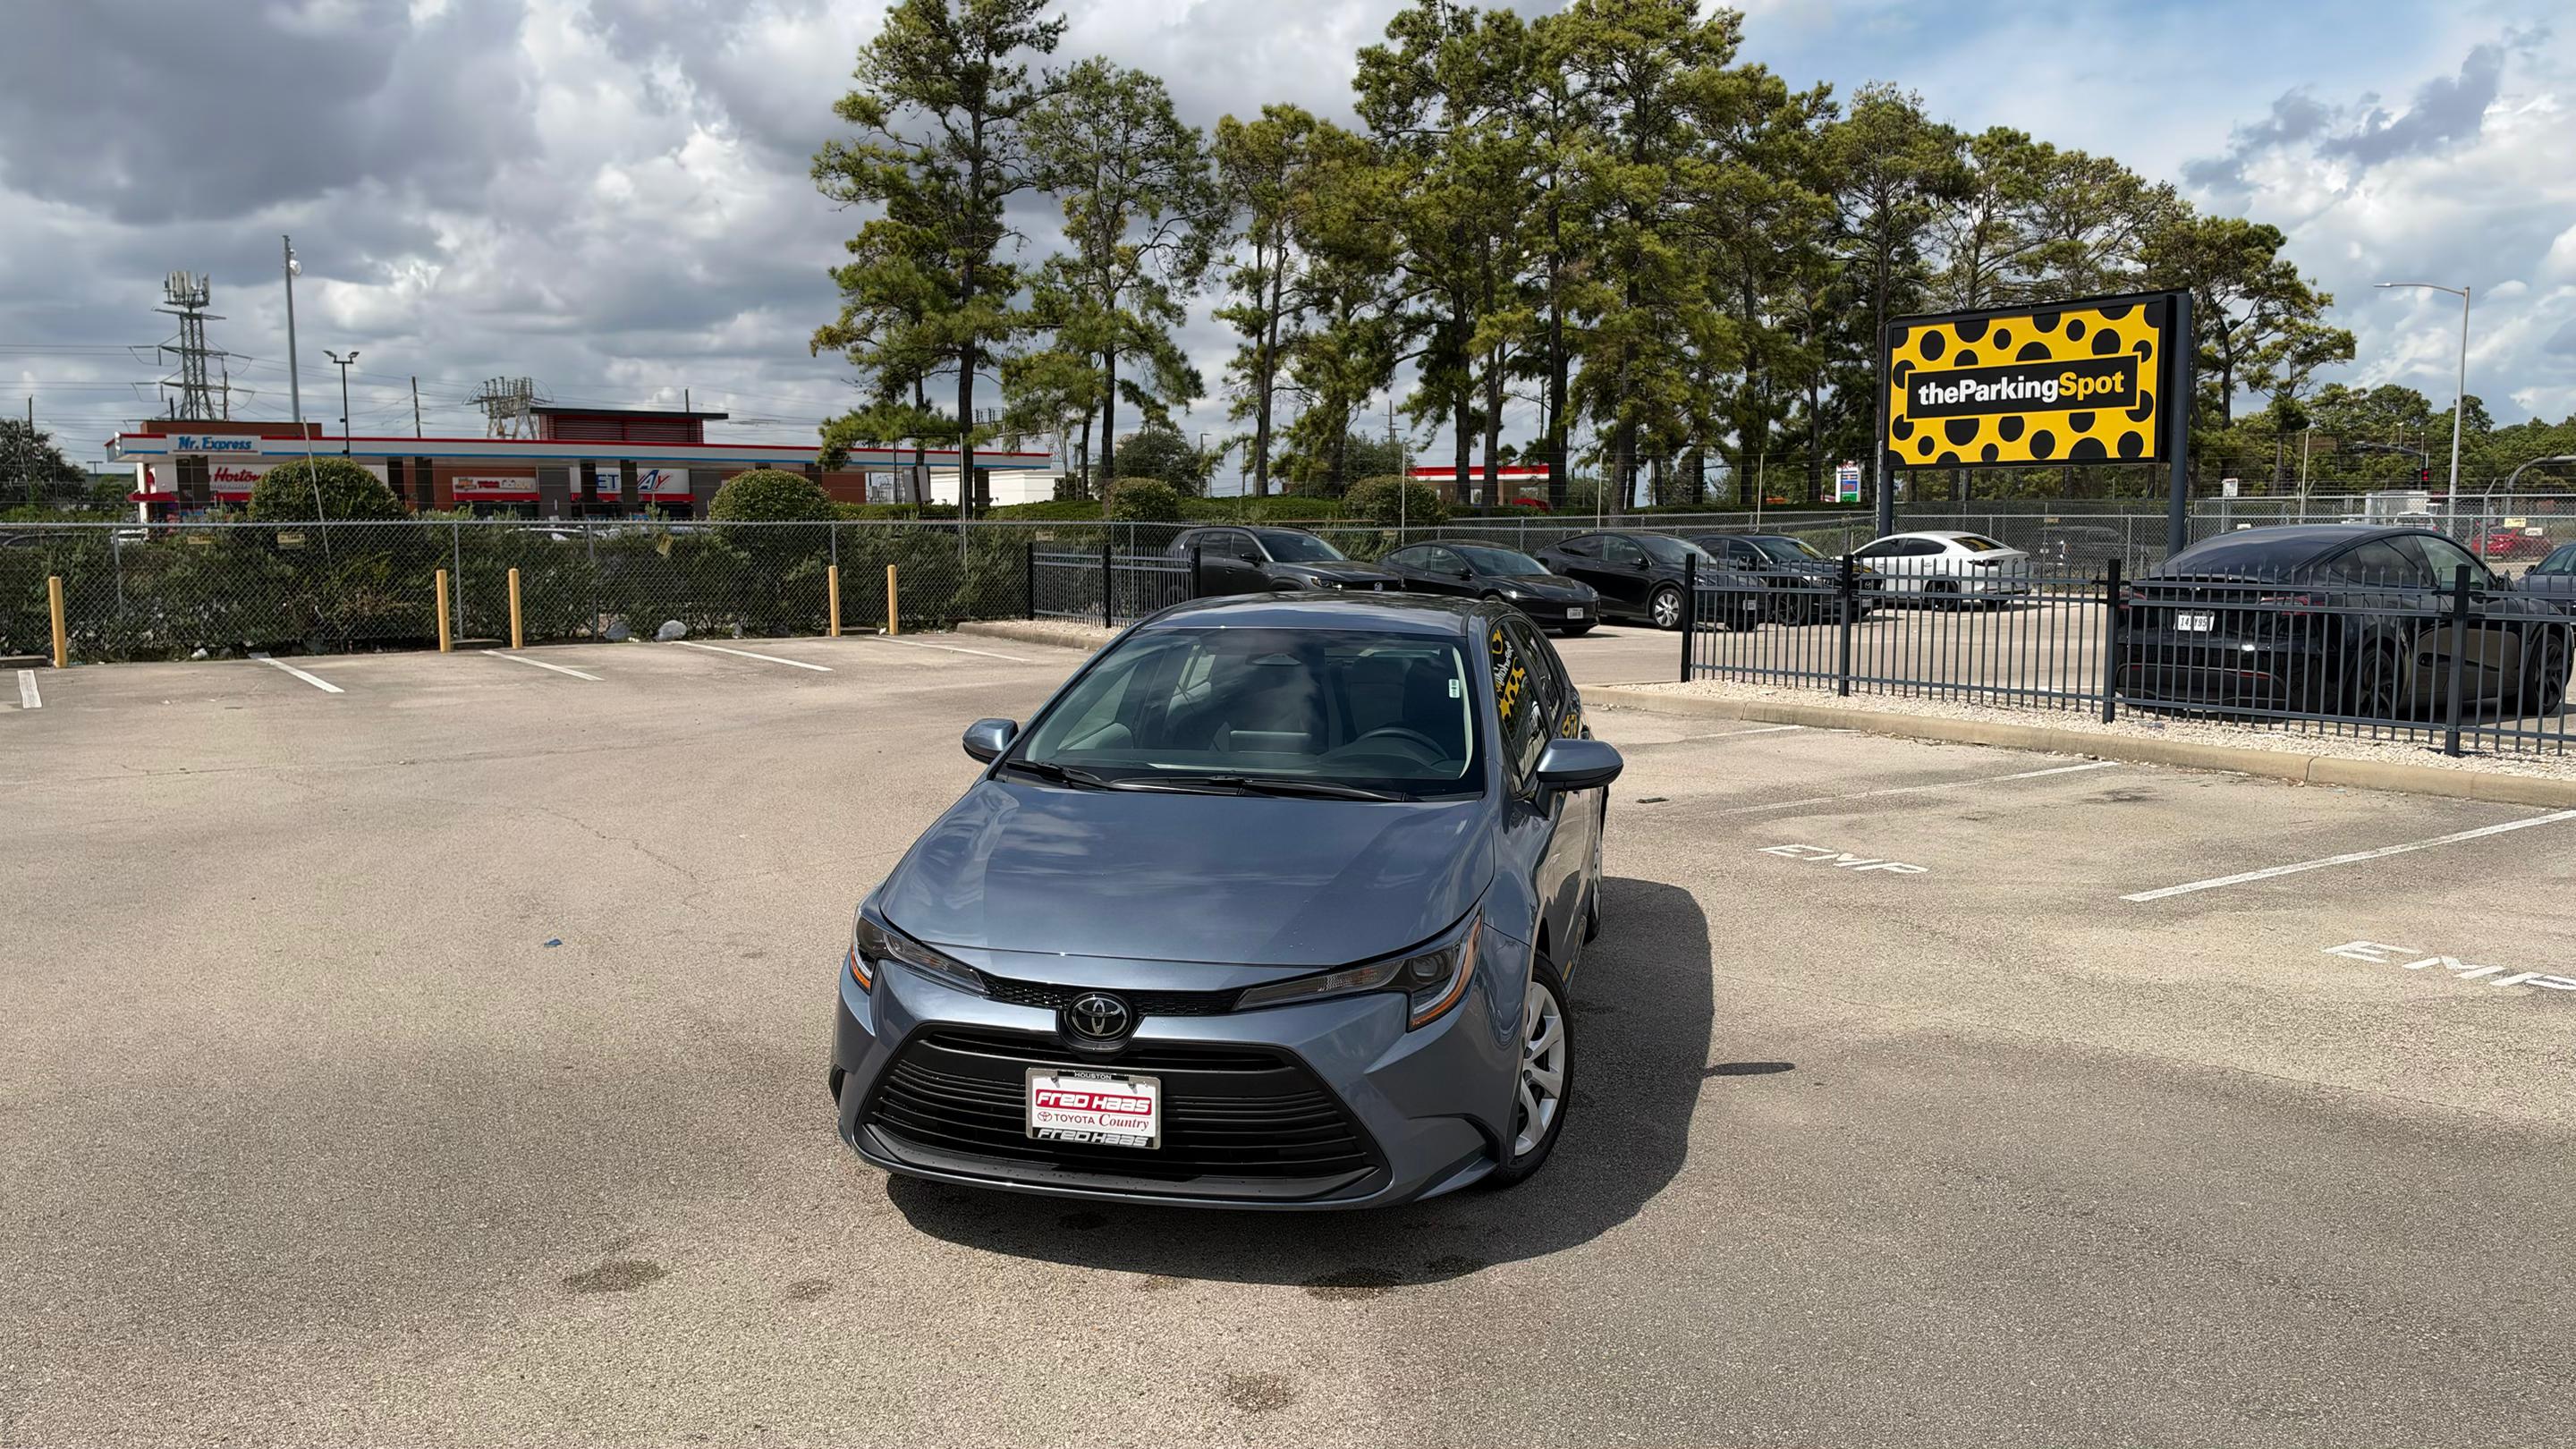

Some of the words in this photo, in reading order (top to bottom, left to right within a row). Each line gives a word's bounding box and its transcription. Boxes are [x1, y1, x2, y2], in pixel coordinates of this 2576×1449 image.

[1918, 370, 2124, 406] theParkingSpot
[178, 436, 199, 449] Mr.
[202, 436, 251, 450] Express
[596, 474, 619, 489] ET
[1074, 1072, 1112, 1080] HOUSTON
[1054, 1114, 1096, 1125] TOYOTA
[1098, 1114, 1149, 1131] Country
